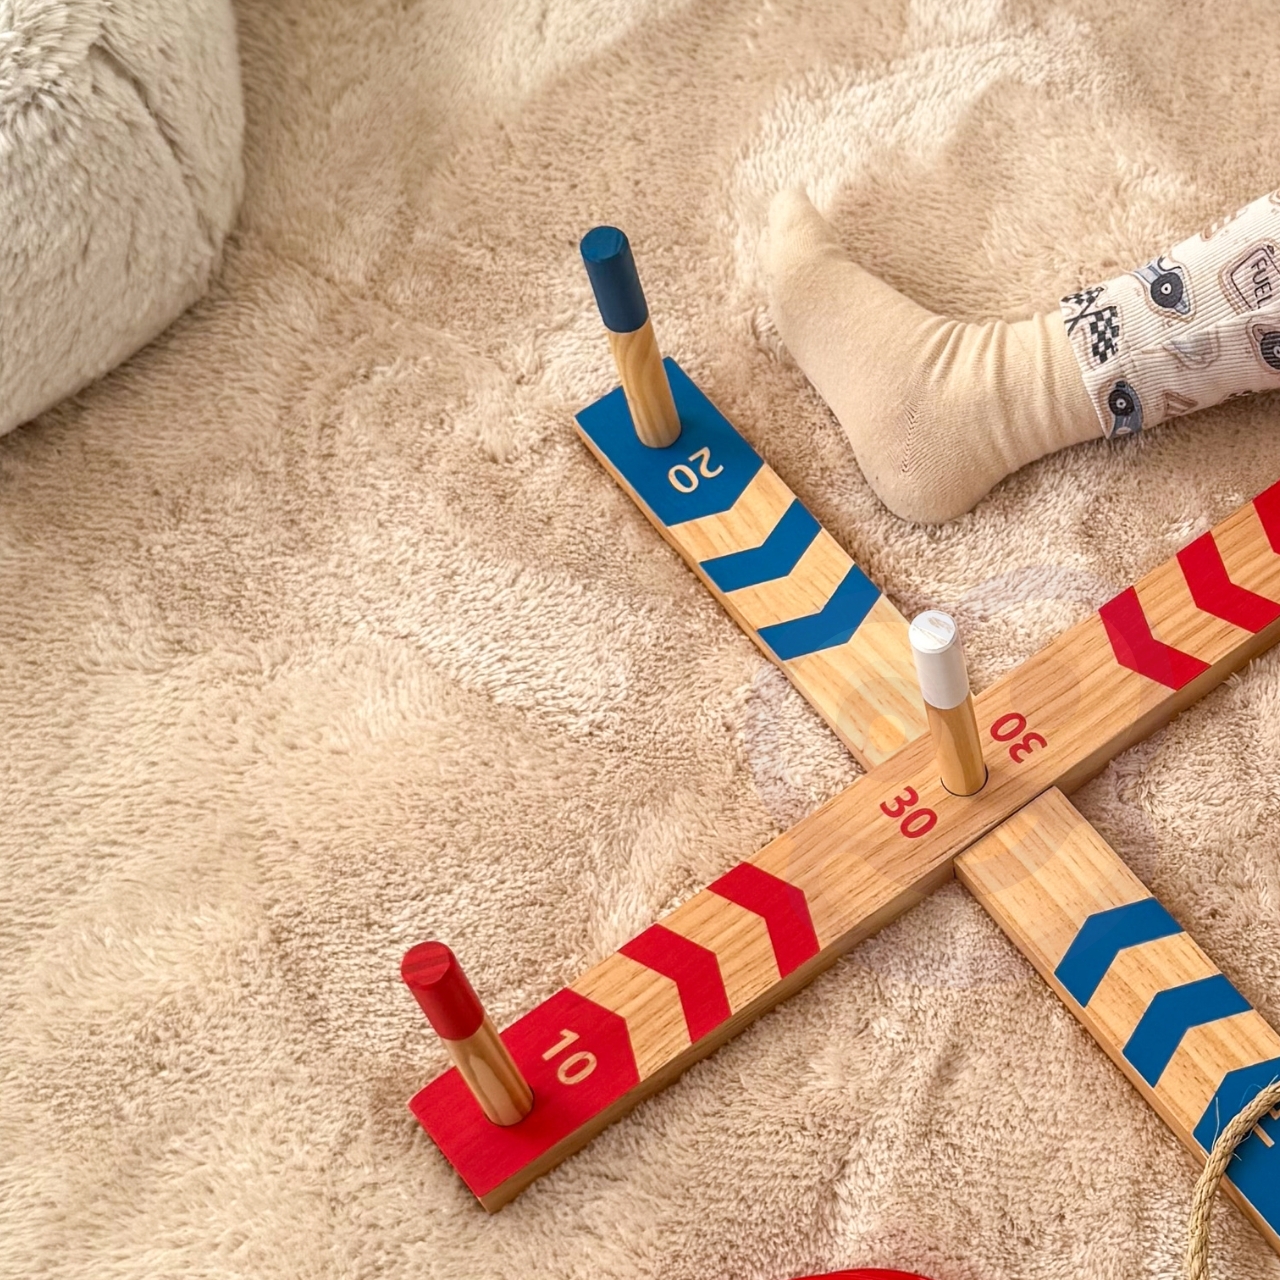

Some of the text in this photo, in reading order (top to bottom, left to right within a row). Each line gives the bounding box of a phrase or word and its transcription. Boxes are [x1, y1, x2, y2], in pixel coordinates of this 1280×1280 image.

[1250, 256, 1273, 310] FUEL
[667, 446, 724, 493] 20
[989, 712, 1048, 764] 30
[879, 785, 938, 839] 30
[541, 1028, 598, 1086] 10
